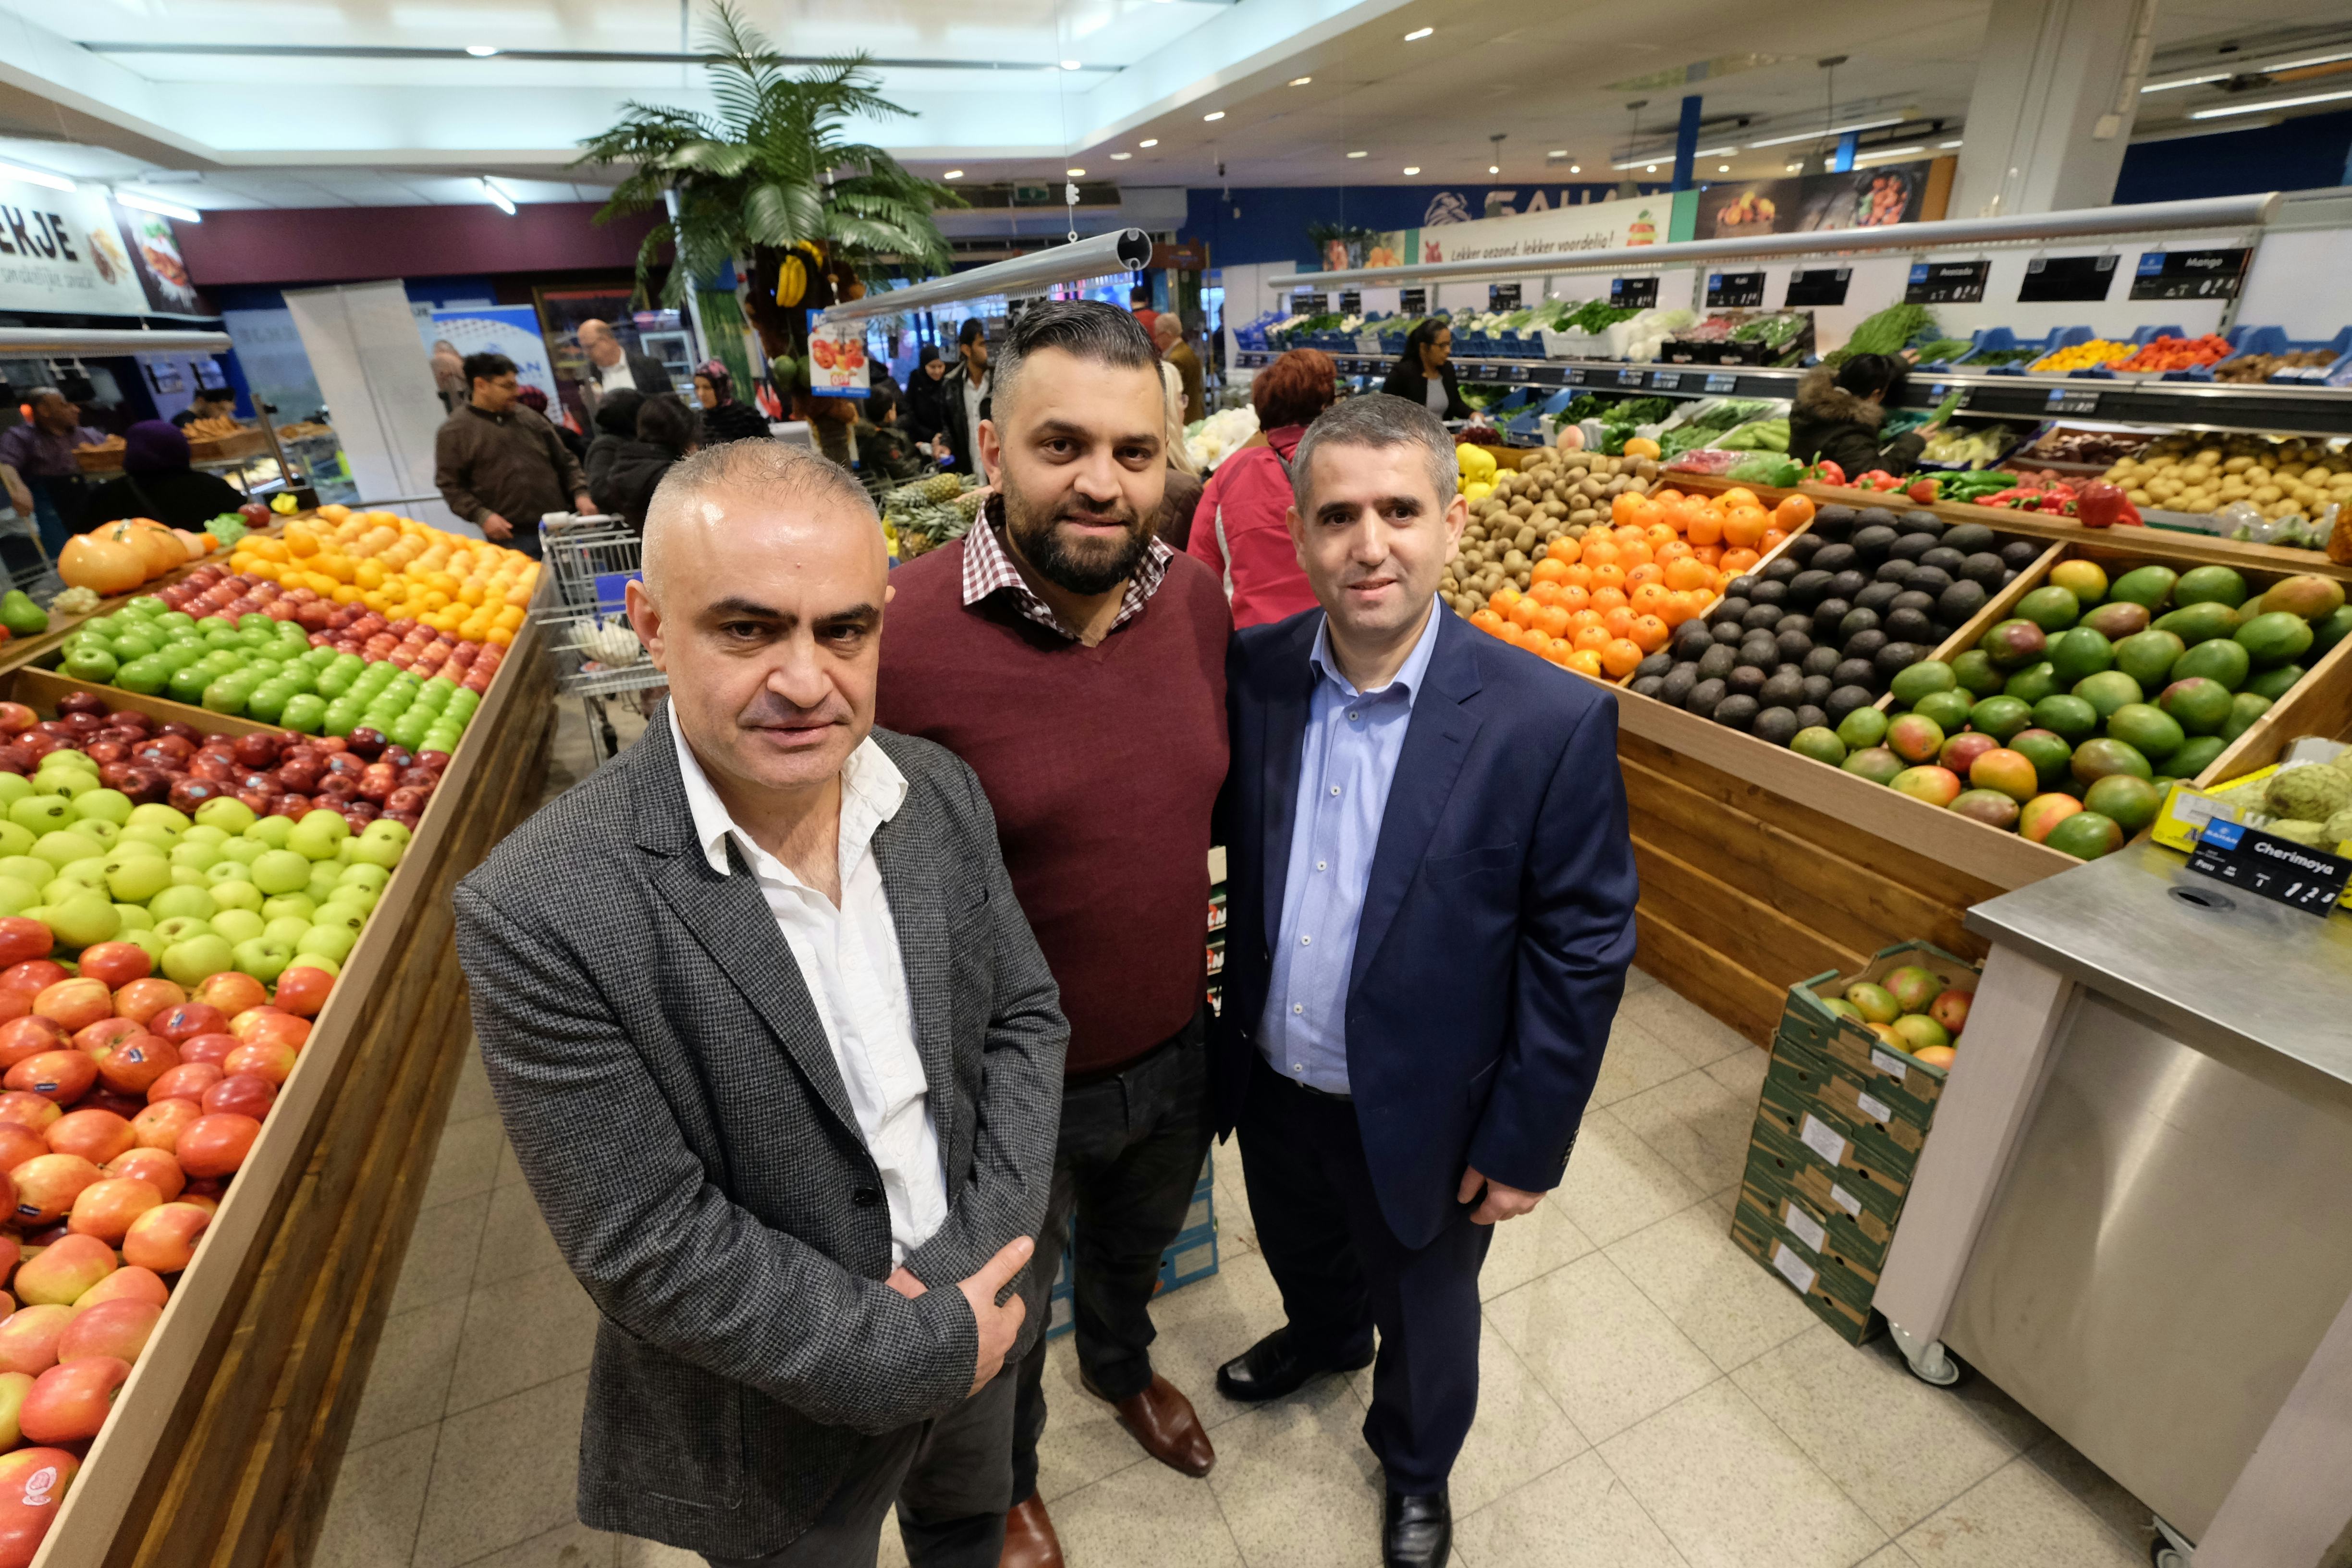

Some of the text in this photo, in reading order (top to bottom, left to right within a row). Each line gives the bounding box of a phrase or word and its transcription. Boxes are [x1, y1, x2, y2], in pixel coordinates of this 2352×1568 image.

[1451, 246, 1481, 261] Lekker
[1522, 239, 1554, 256] lekker
[2254, 841, 2335, 876] Cherimoya
